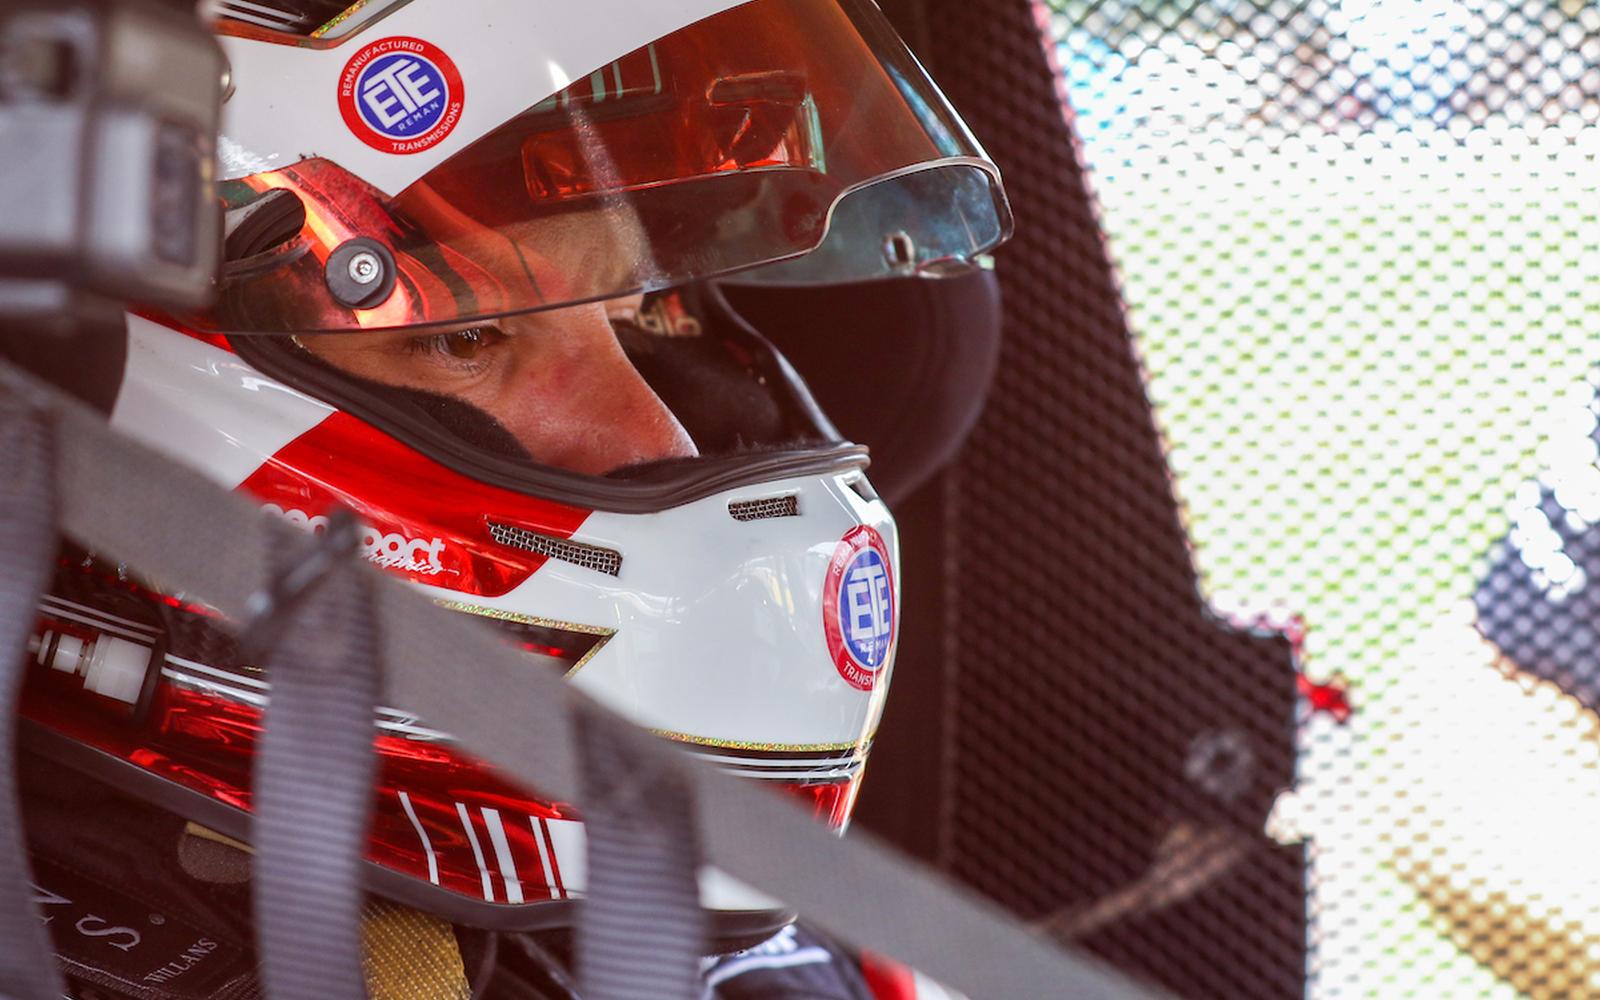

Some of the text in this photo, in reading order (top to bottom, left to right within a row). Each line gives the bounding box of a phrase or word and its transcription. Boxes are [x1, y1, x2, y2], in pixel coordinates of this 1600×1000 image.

[343, 40, 424, 97] REMANUFACTURED
[362, 58, 441, 129] ETE
[391, 102, 461, 151] TRANSMISSIONS
[397, 101, 439, 131] REMAN
[847, 565, 890, 641] ETE
[143, 937, 218, 984] WILLANS
